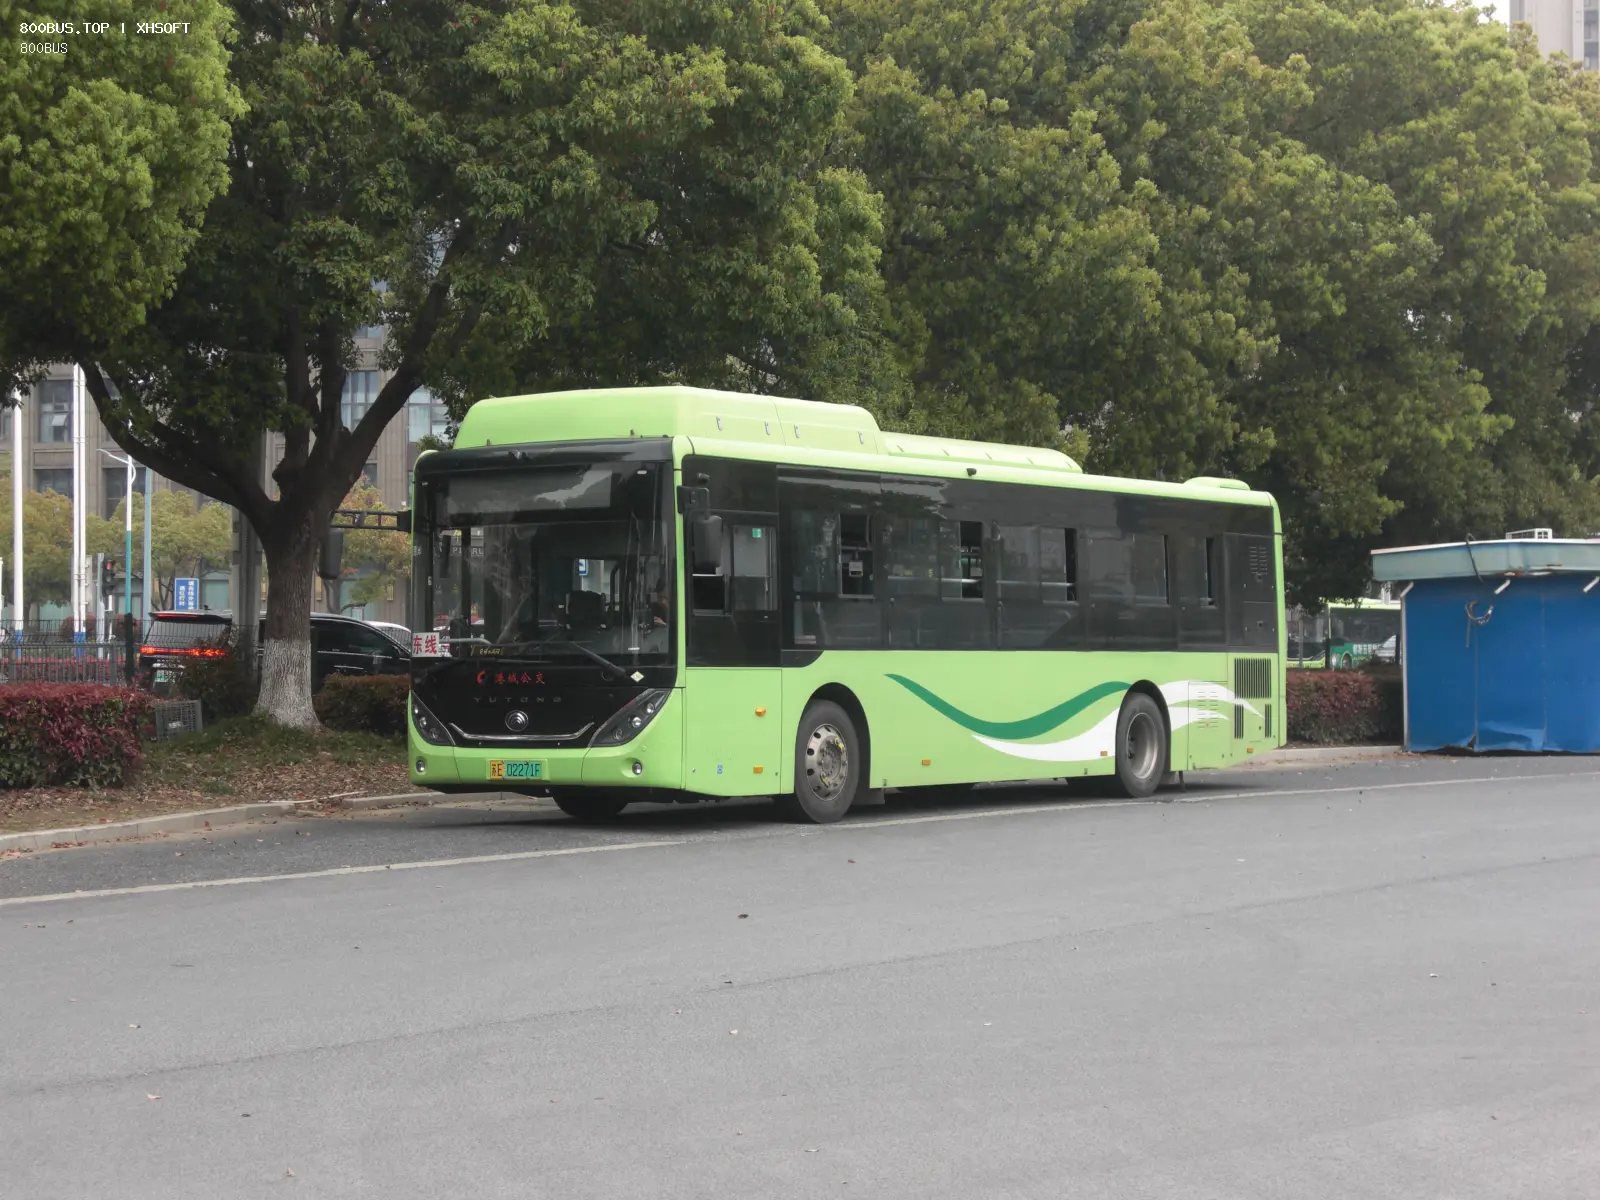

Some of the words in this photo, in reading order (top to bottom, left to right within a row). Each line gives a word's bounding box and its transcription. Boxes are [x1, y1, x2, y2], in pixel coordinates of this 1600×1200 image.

[413, 634, 438, 654] 东线
[494, 670, 546, 685] 港城公交
